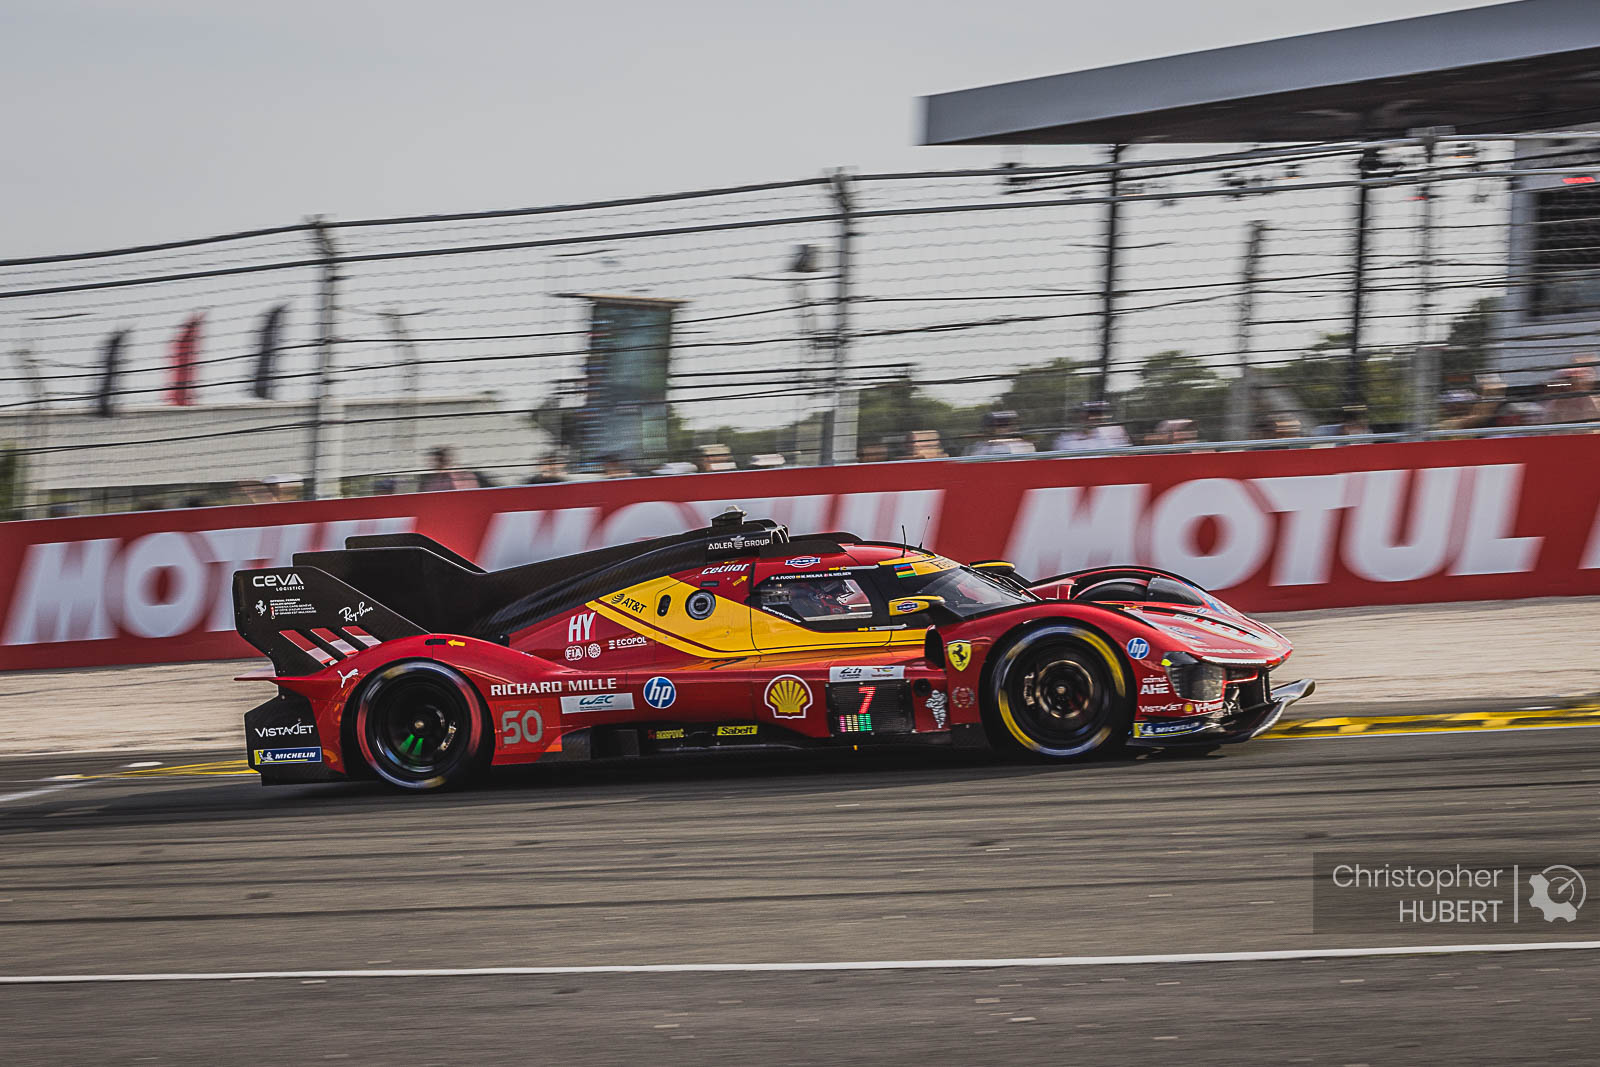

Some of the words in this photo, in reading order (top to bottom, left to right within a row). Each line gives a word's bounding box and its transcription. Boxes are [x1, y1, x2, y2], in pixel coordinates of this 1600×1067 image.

[1003, 463, 1546, 590] MOTUL
[707, 541, 733, 550] ADLER
[744, 538, 770, 547] GROUP
[338, 601, 374, 622] Ray-Ban
[621, 597, 647, 614] AT&T
[568, 612, 596, 643] HY
[616, 636, 647, 646] ECOPOL
[1130, 637, 1147, 660] hp
[566, 648, 583, 660] FIA
[490, 681, 562, 696] RICHARD
[568, 677, 617, 692] MILLE
[648, 677, 672, 708] hp
[579, 695, 614, 705] WEC
[858, 686, 876, 714] 7
[501, 709, 543, 744] 50
[720, 726, 754, 735] Sabelt
[275, 752, 316, 760] MICHELIN
